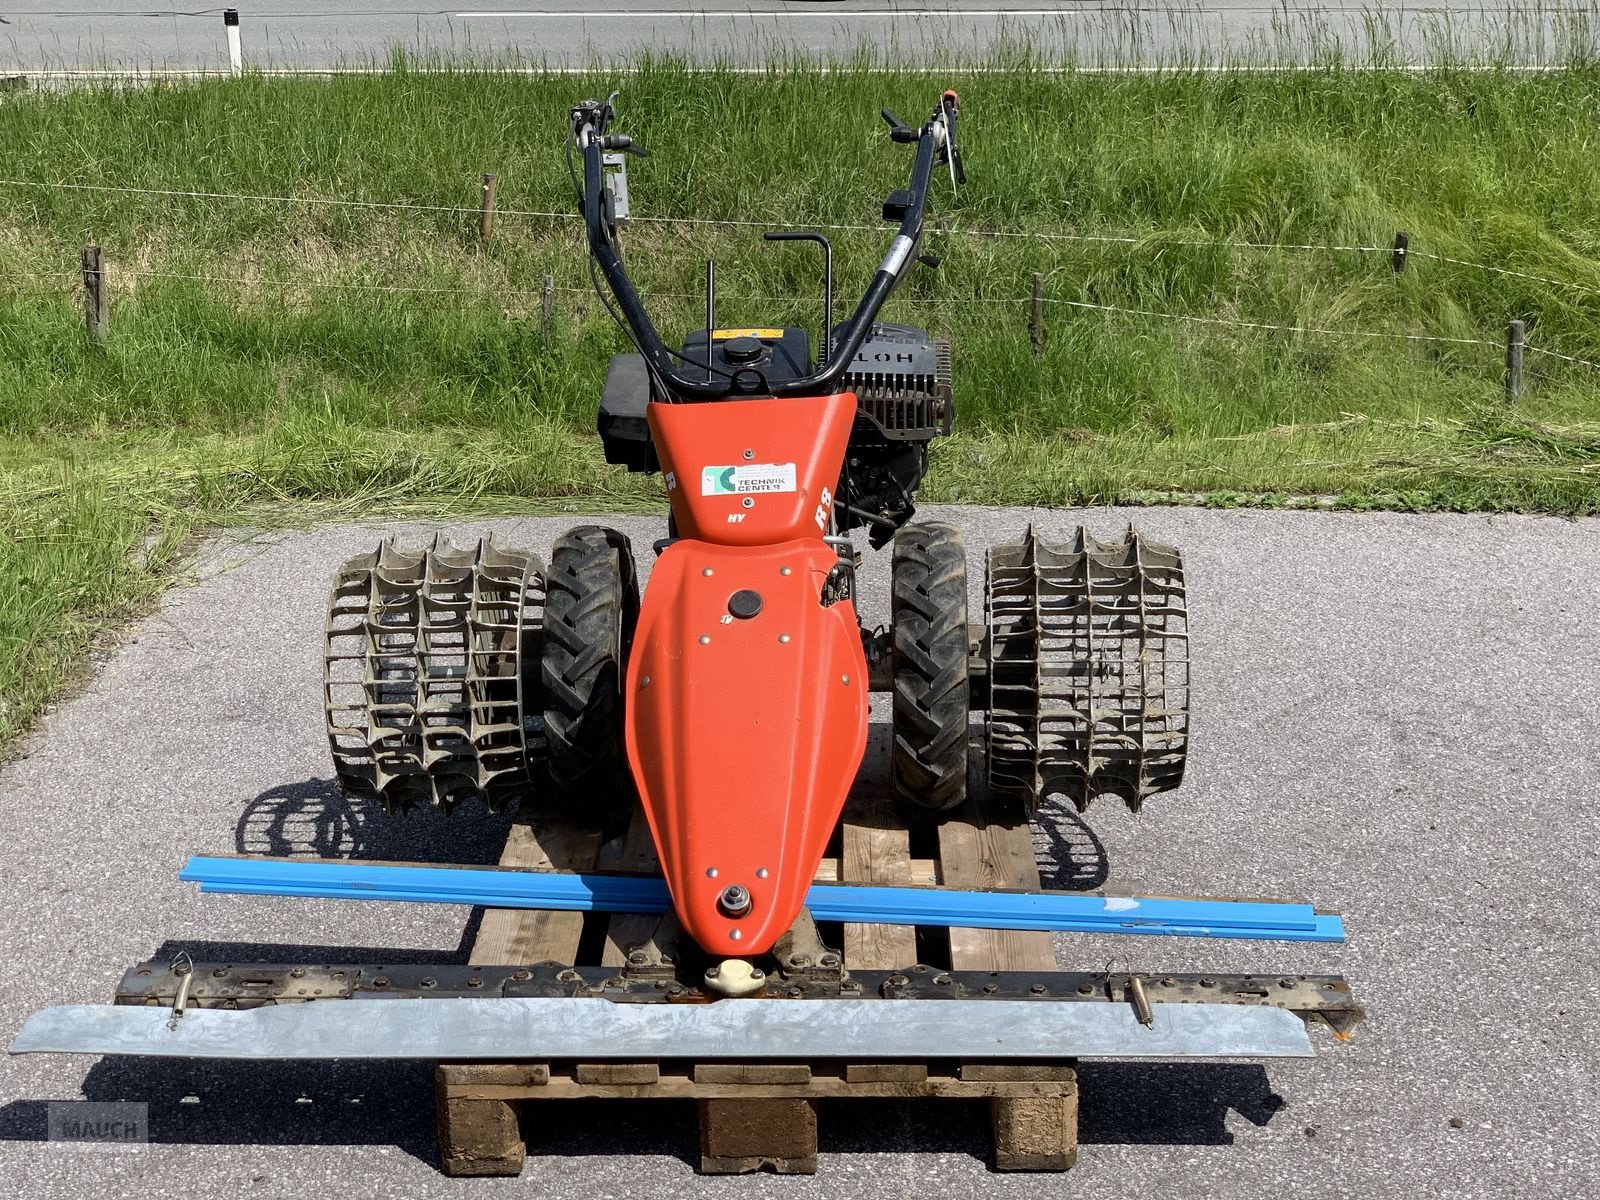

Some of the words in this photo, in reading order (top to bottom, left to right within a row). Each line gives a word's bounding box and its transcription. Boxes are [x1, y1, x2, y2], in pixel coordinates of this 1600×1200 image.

[738, 478, 786, 486] TECHNIK
[738, 484, 781, 492] CENTER
[727, 513, 746, 524] HY
